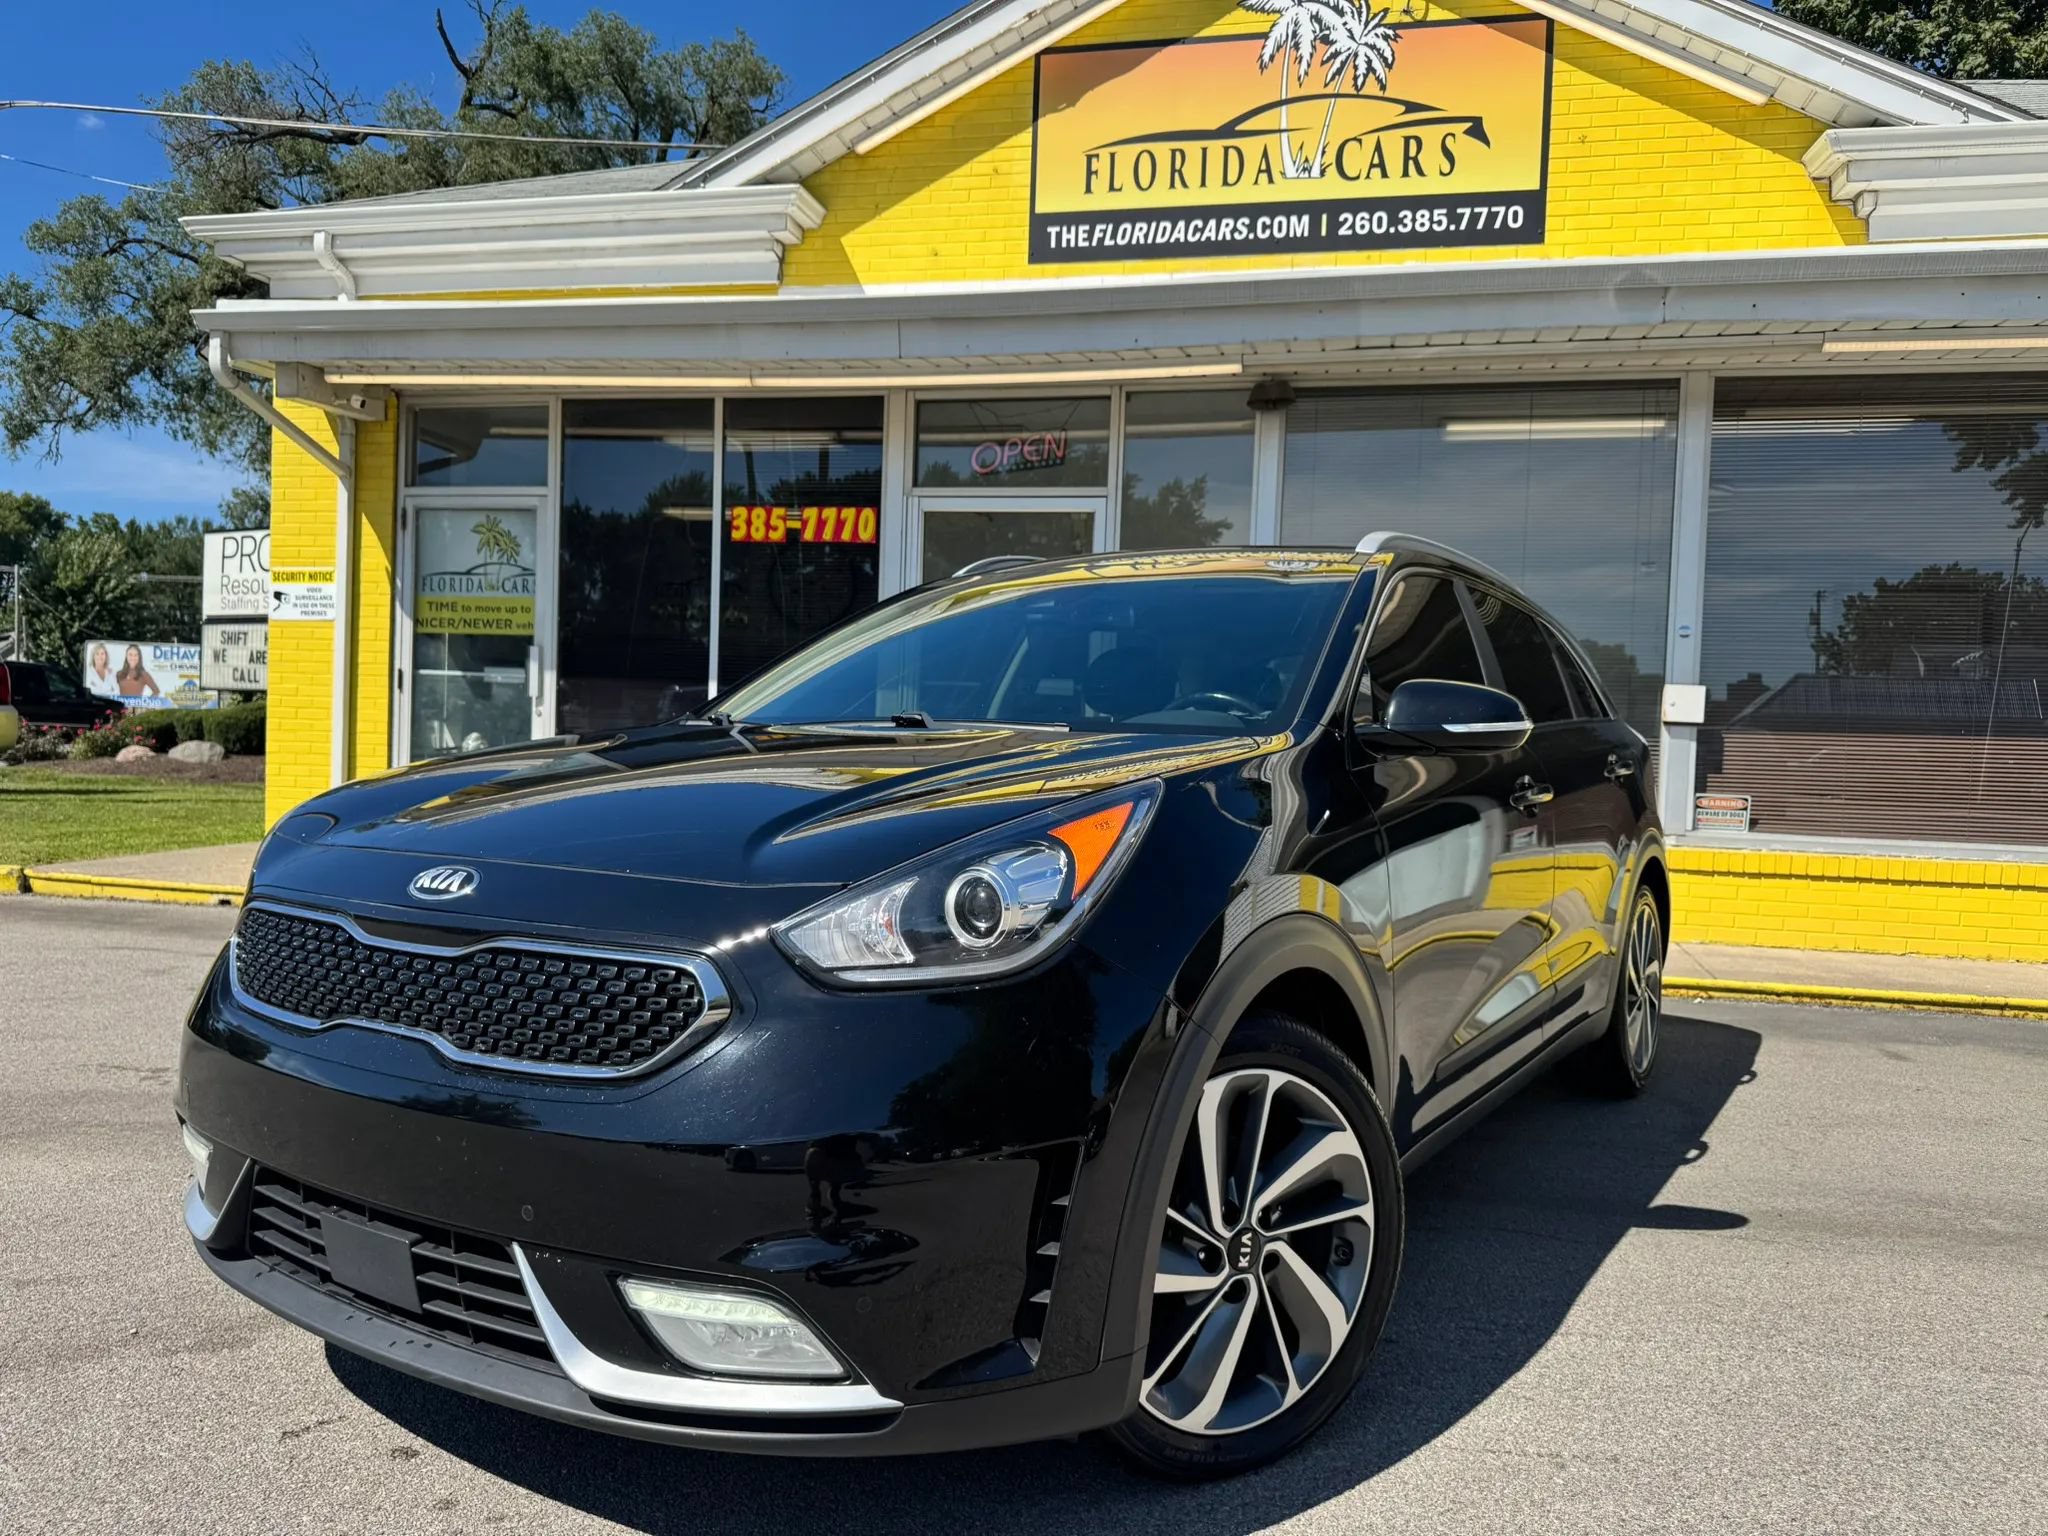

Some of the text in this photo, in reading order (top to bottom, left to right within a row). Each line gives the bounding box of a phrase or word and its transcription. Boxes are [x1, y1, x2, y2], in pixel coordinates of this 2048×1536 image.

[1083, 132, 1457, 195] FLORIDA CARS
[1046, 205, 1525, 249] THEFLORIDACARS.COM 260.385.7770
[971, 430, 1068, 475] OPEN
[272, 571, 334, 582] SECURITY NOTICE
[421, 575, 536, 593] FLORIDA CAR
[221, 596, 260, 612] Staffing
[427, 601, 532, 615] TIME to move up to
[415, 616, 512, 631] NICER/NEWER
[220, 630, 248, 646] SHIFT
[213, 648, 267, 664] WE ARE
[232, 668, 260, 684] CALL
[415, 869, 468, 892] KIA
[1238, 1232, 1253, 1267] KIA
